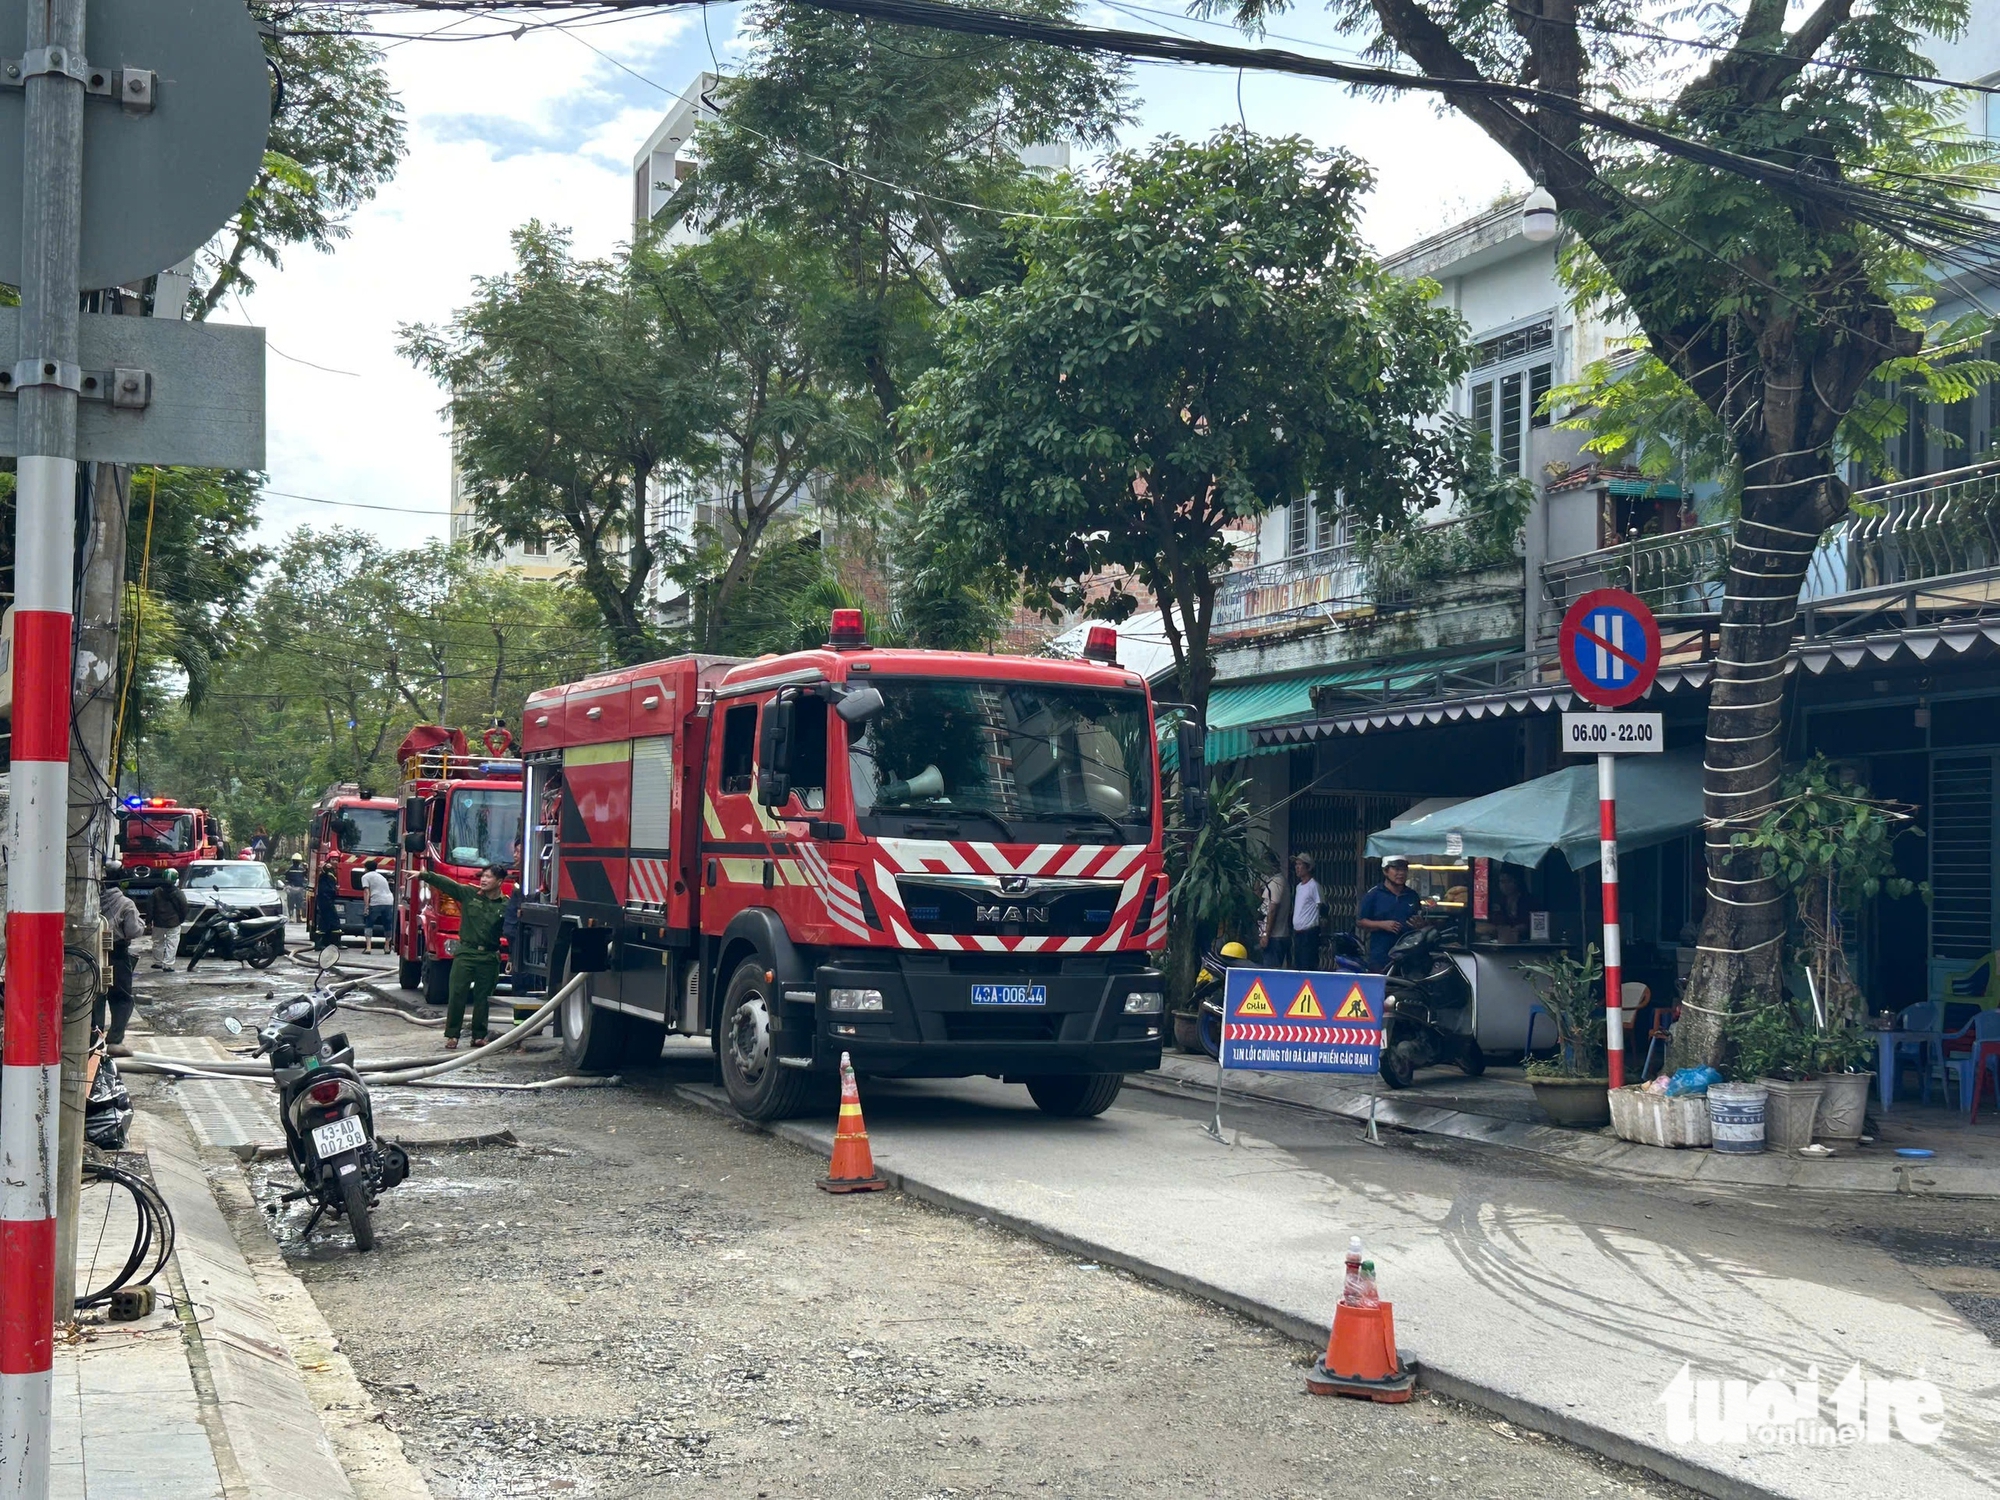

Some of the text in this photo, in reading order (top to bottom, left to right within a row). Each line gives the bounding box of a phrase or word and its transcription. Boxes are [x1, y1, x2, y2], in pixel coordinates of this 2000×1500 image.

[1572, 724, 1606, 741] 06.00
[1618, 724, 1652, 741] 22.00
[976, 906, 1049, 922] MAN
[974, 986, 1043, 1003] 43A-006.44
[321, 1121, 352, 1140] 43-AD
[321, 1132, 362, 1155] 002.98
